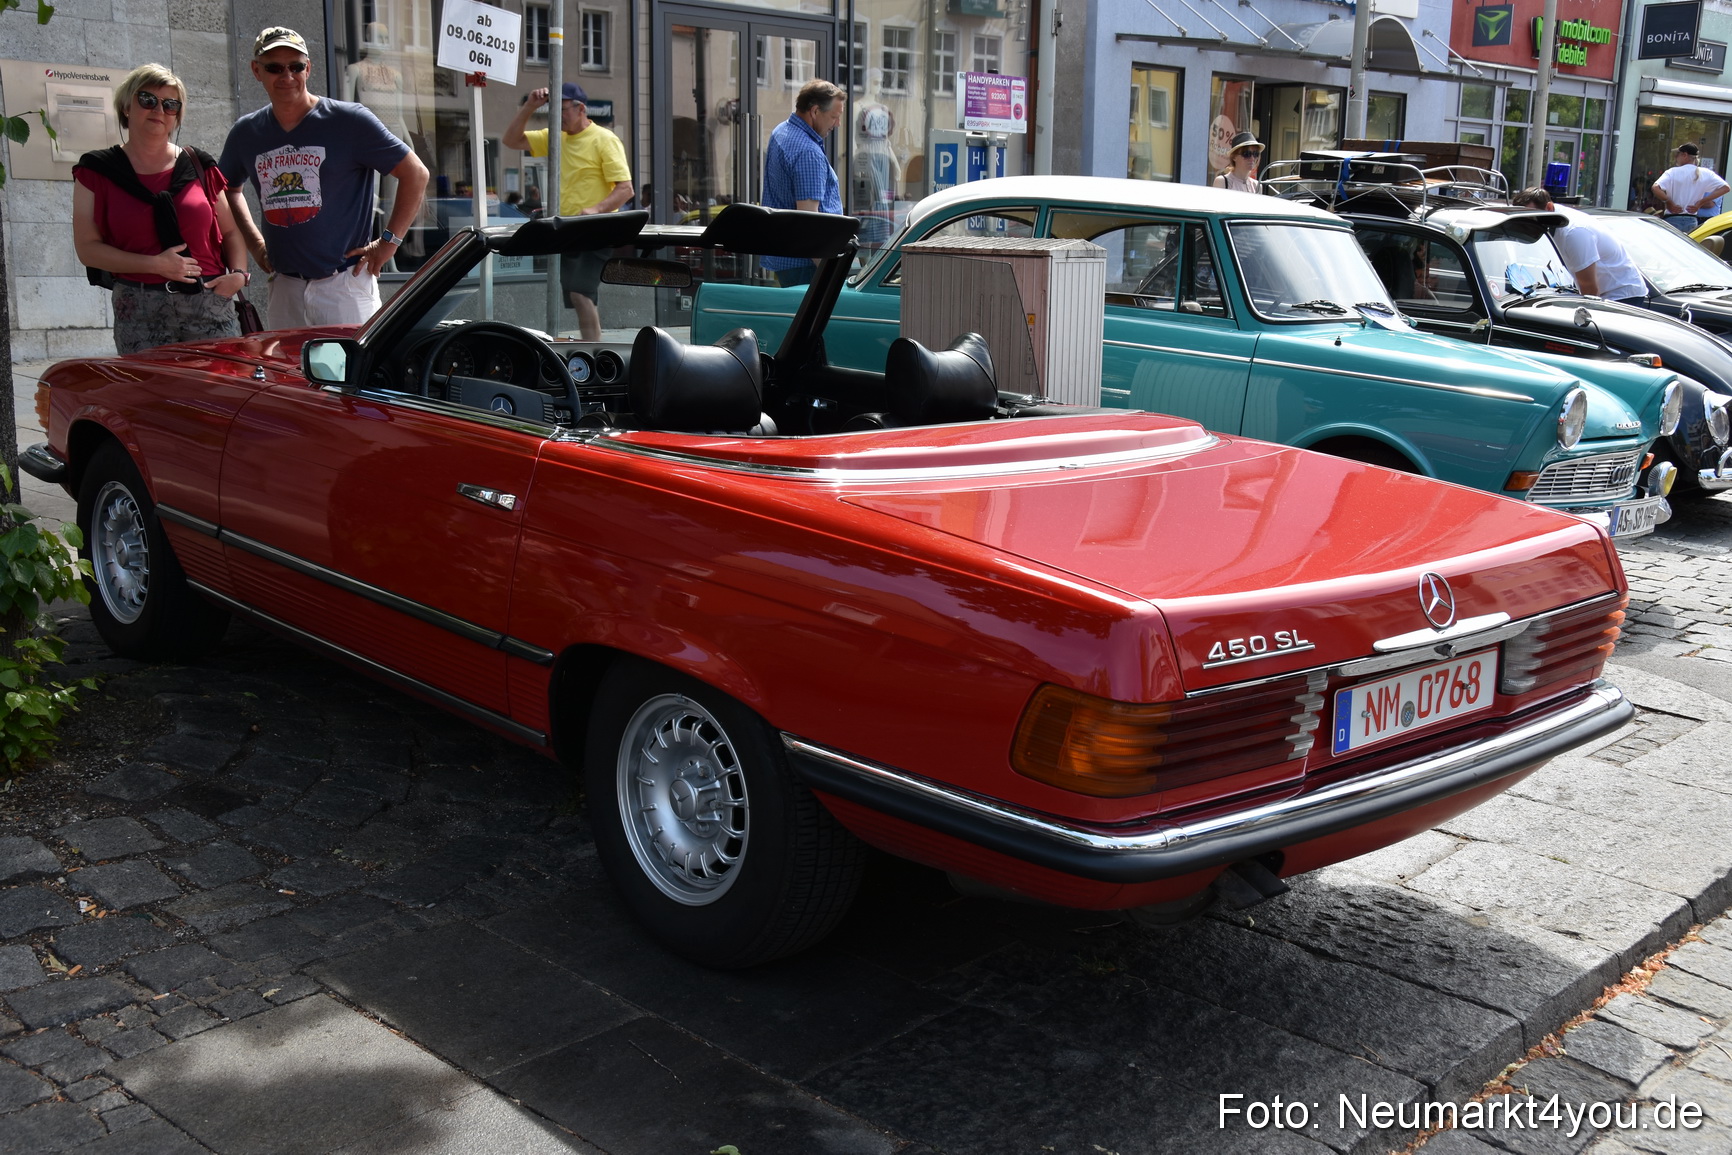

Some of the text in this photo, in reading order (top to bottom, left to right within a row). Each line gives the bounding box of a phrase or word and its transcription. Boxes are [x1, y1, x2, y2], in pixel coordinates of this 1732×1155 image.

[477, 14, 492, 28] ab
[1560, 18, 1612, 45] mobilcom
[446, 24, 516, 54] 09.06.2019
[1646, 30, 1691, 45] BONITA
[469, 50, 492, 67] 06h
[1558, 42, 1588, 67] debitel
[1690, 43, 1713, 65] ONITA
[53, 70, 111, 81] HypoVereinsbank
[967, 74, 1010, 87] HANDYPARKEN
[1212, 124, 1234, 145] 50%
[257, 153, 321, 173] SAN FRANCISCO
[939, 151, 954, 178] P
[972, 151, 1000, 167] HIR
[1616, 509, 1630, 532] AS
[1207, 629, 1309, 661] 450 SL
[1364, 660, 1482, 737] NM 0768
[1338, 728, 1345, 743] D
